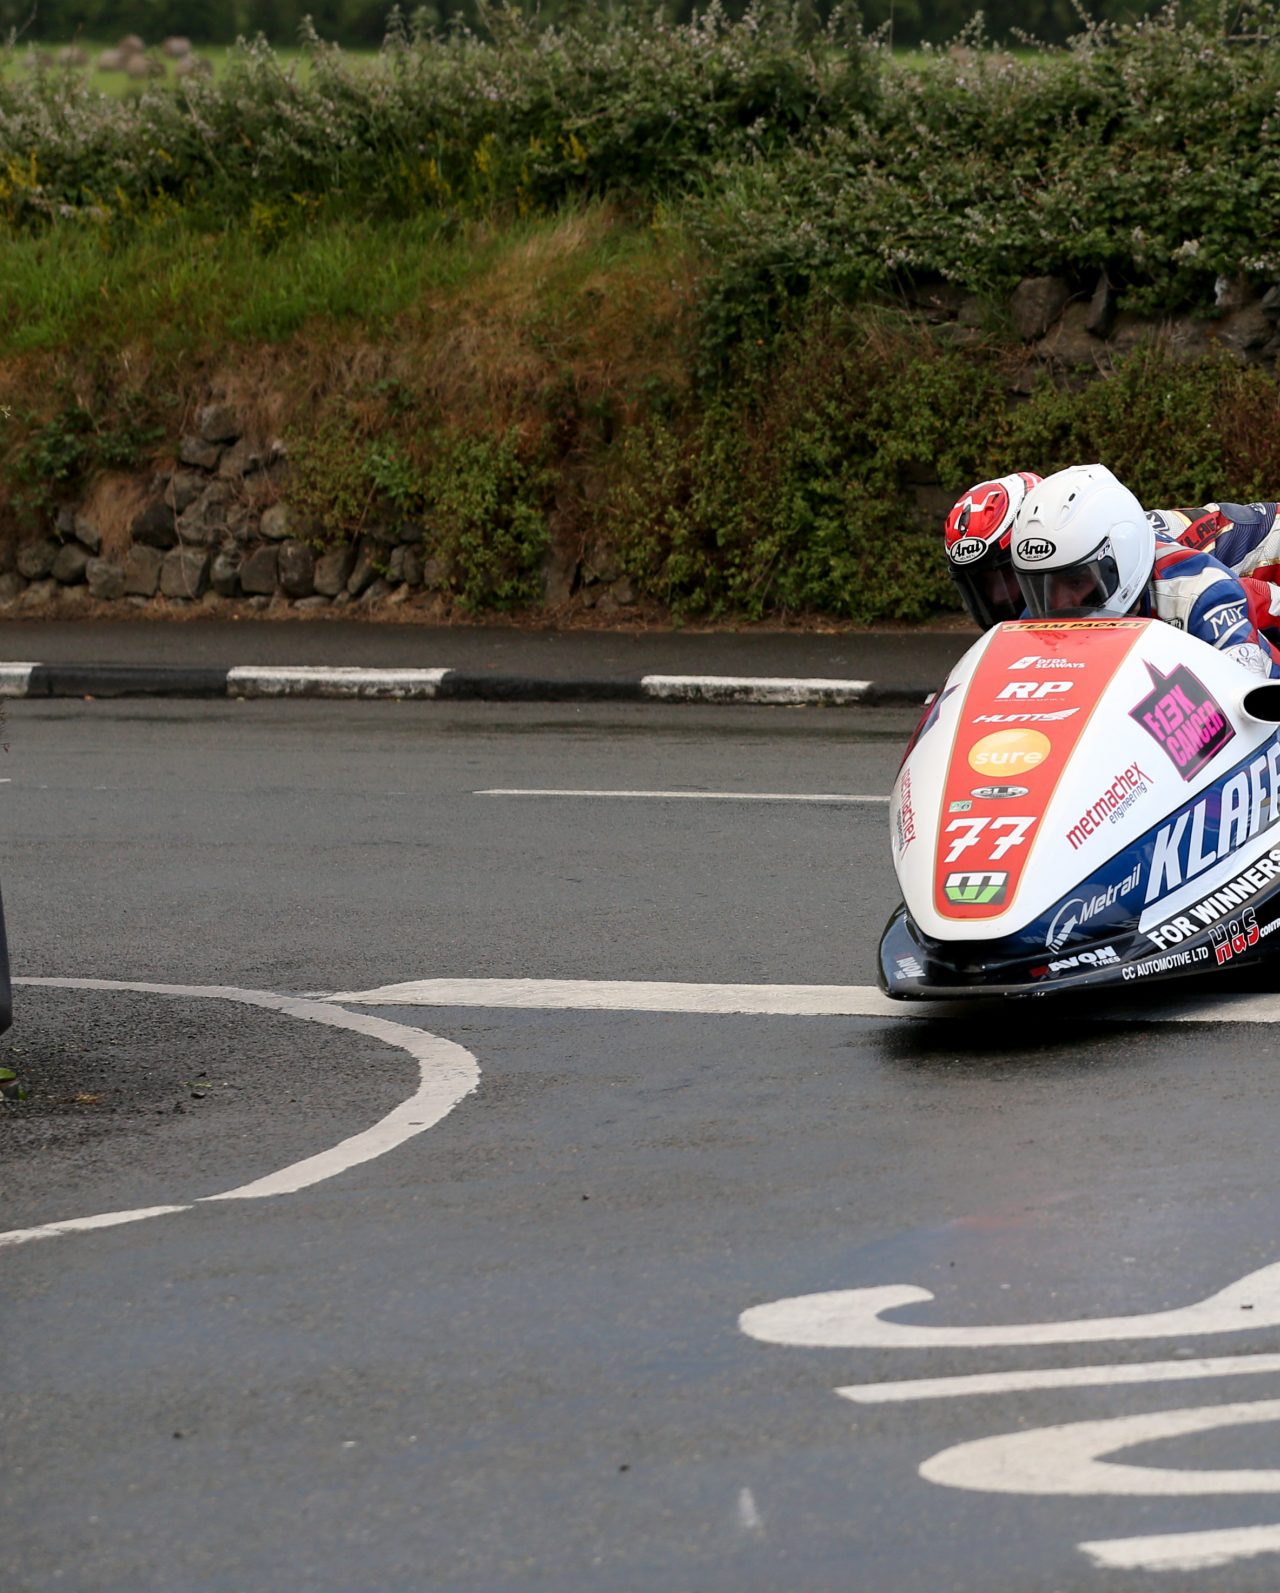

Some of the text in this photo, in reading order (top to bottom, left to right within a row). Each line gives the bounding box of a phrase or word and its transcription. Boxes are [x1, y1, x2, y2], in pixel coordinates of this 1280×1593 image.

[954, 540, 981, 557] Arai
[1022, 541, 1050, 555] Arai
[1004, 621, 1145, 631] STEAM PACKET
[1210, 605, 1244, 639] MJY
[996, 681, 1074, 699] RP
[1165, 701, 1225, 767] CANCER
[974, 750, 1043, 765] sure
[1066, 762, 1154, 850] metmachex
[1109, 781, 1149, 824] engineering
[943, 816, 1038, 862] 77
[1079, 863, 1141, 925] Metrail
[1147, 913, 1201, 951] FOR
[1208, 906, 1260, 965] H&S
[1048, 945, 1117, 972] AVON
[1091, 955, 1121, 969] TYRES
[1121, 946, 1209, 981] CC AUTOMOTIVE LTD
